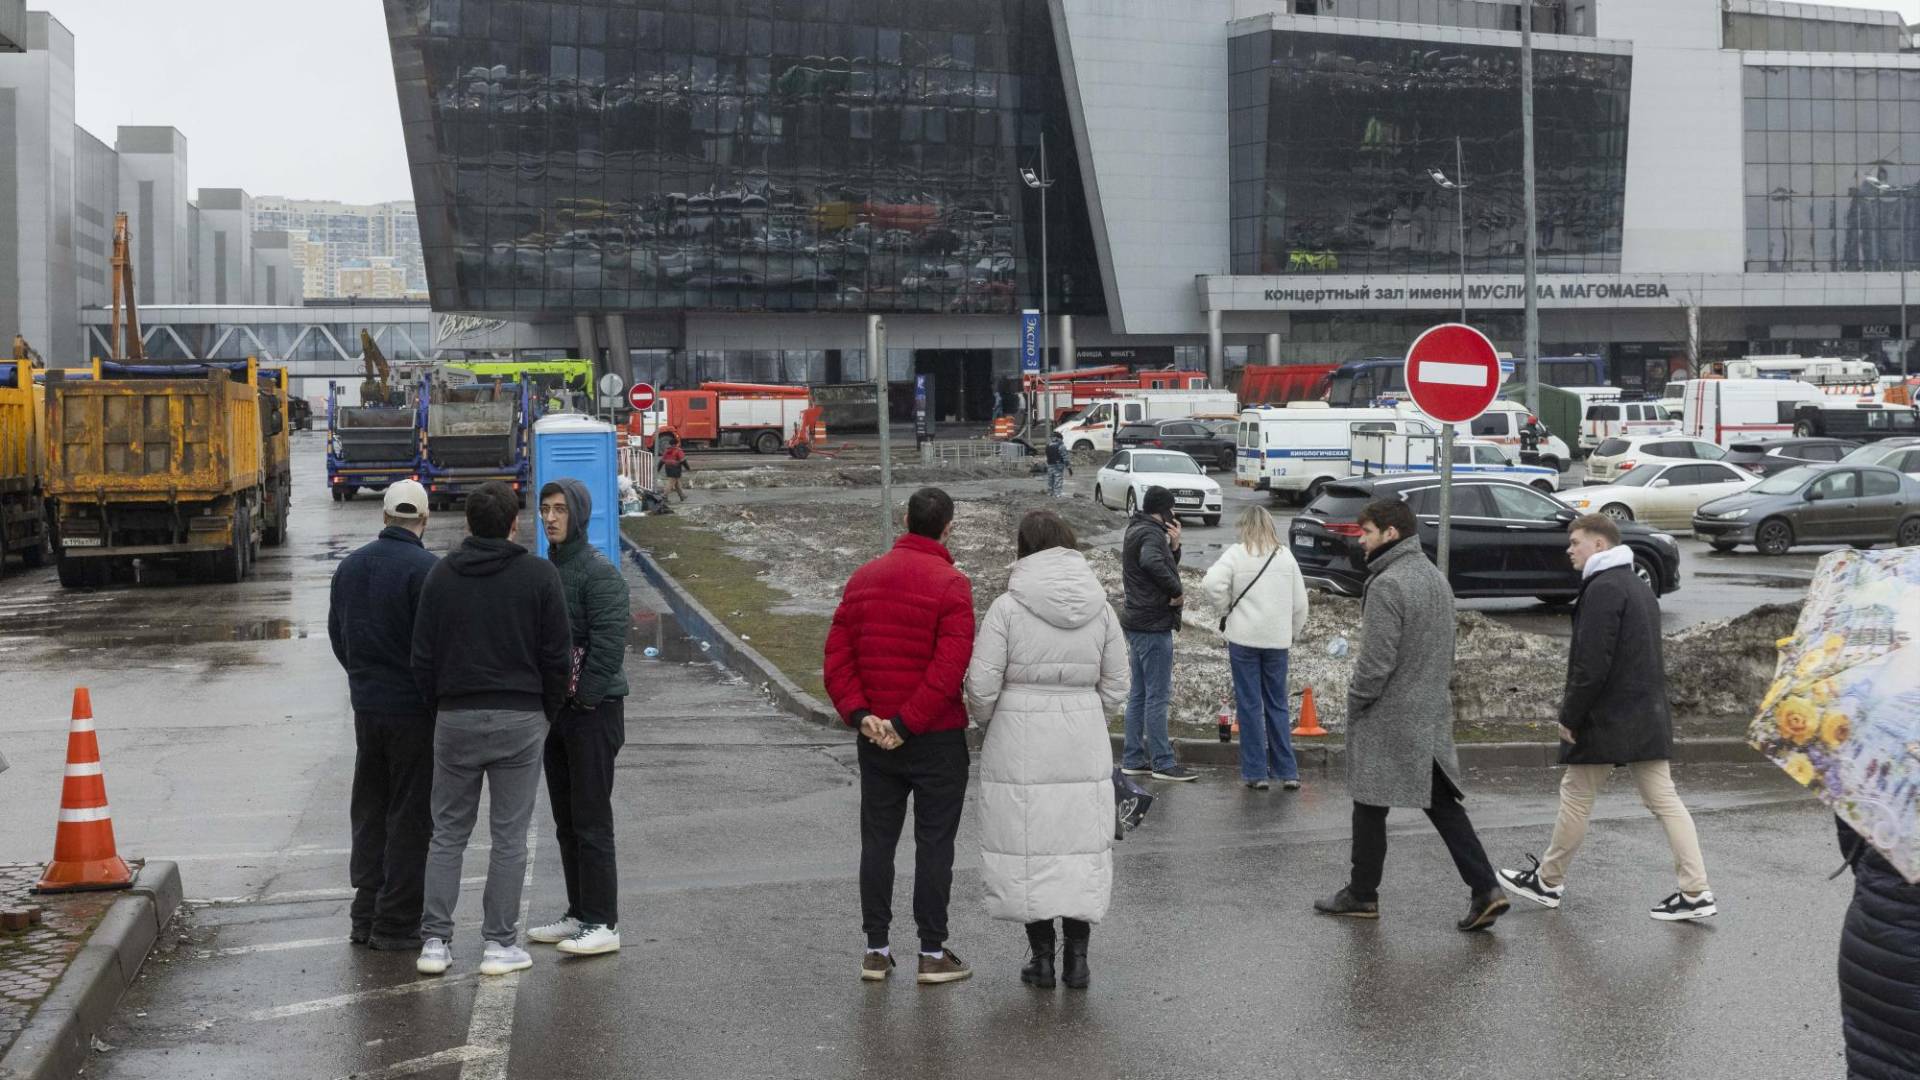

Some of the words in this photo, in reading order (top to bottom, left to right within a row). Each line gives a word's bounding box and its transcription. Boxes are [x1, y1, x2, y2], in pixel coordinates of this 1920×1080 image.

[1264, 284, 1370, 304] концертный
[1375, 288, 1404, 300] зал
[1410, 288, 1463, 300] имени
[1560, 284, 1669, 298] МАГОМАЕВА
[1862, 325, 1890, 335] КАССА
[1290, 450, 1349, 458] КИНОЛОГИЧЕСКАЯ
[1273, 467, 1287, 476] 112
